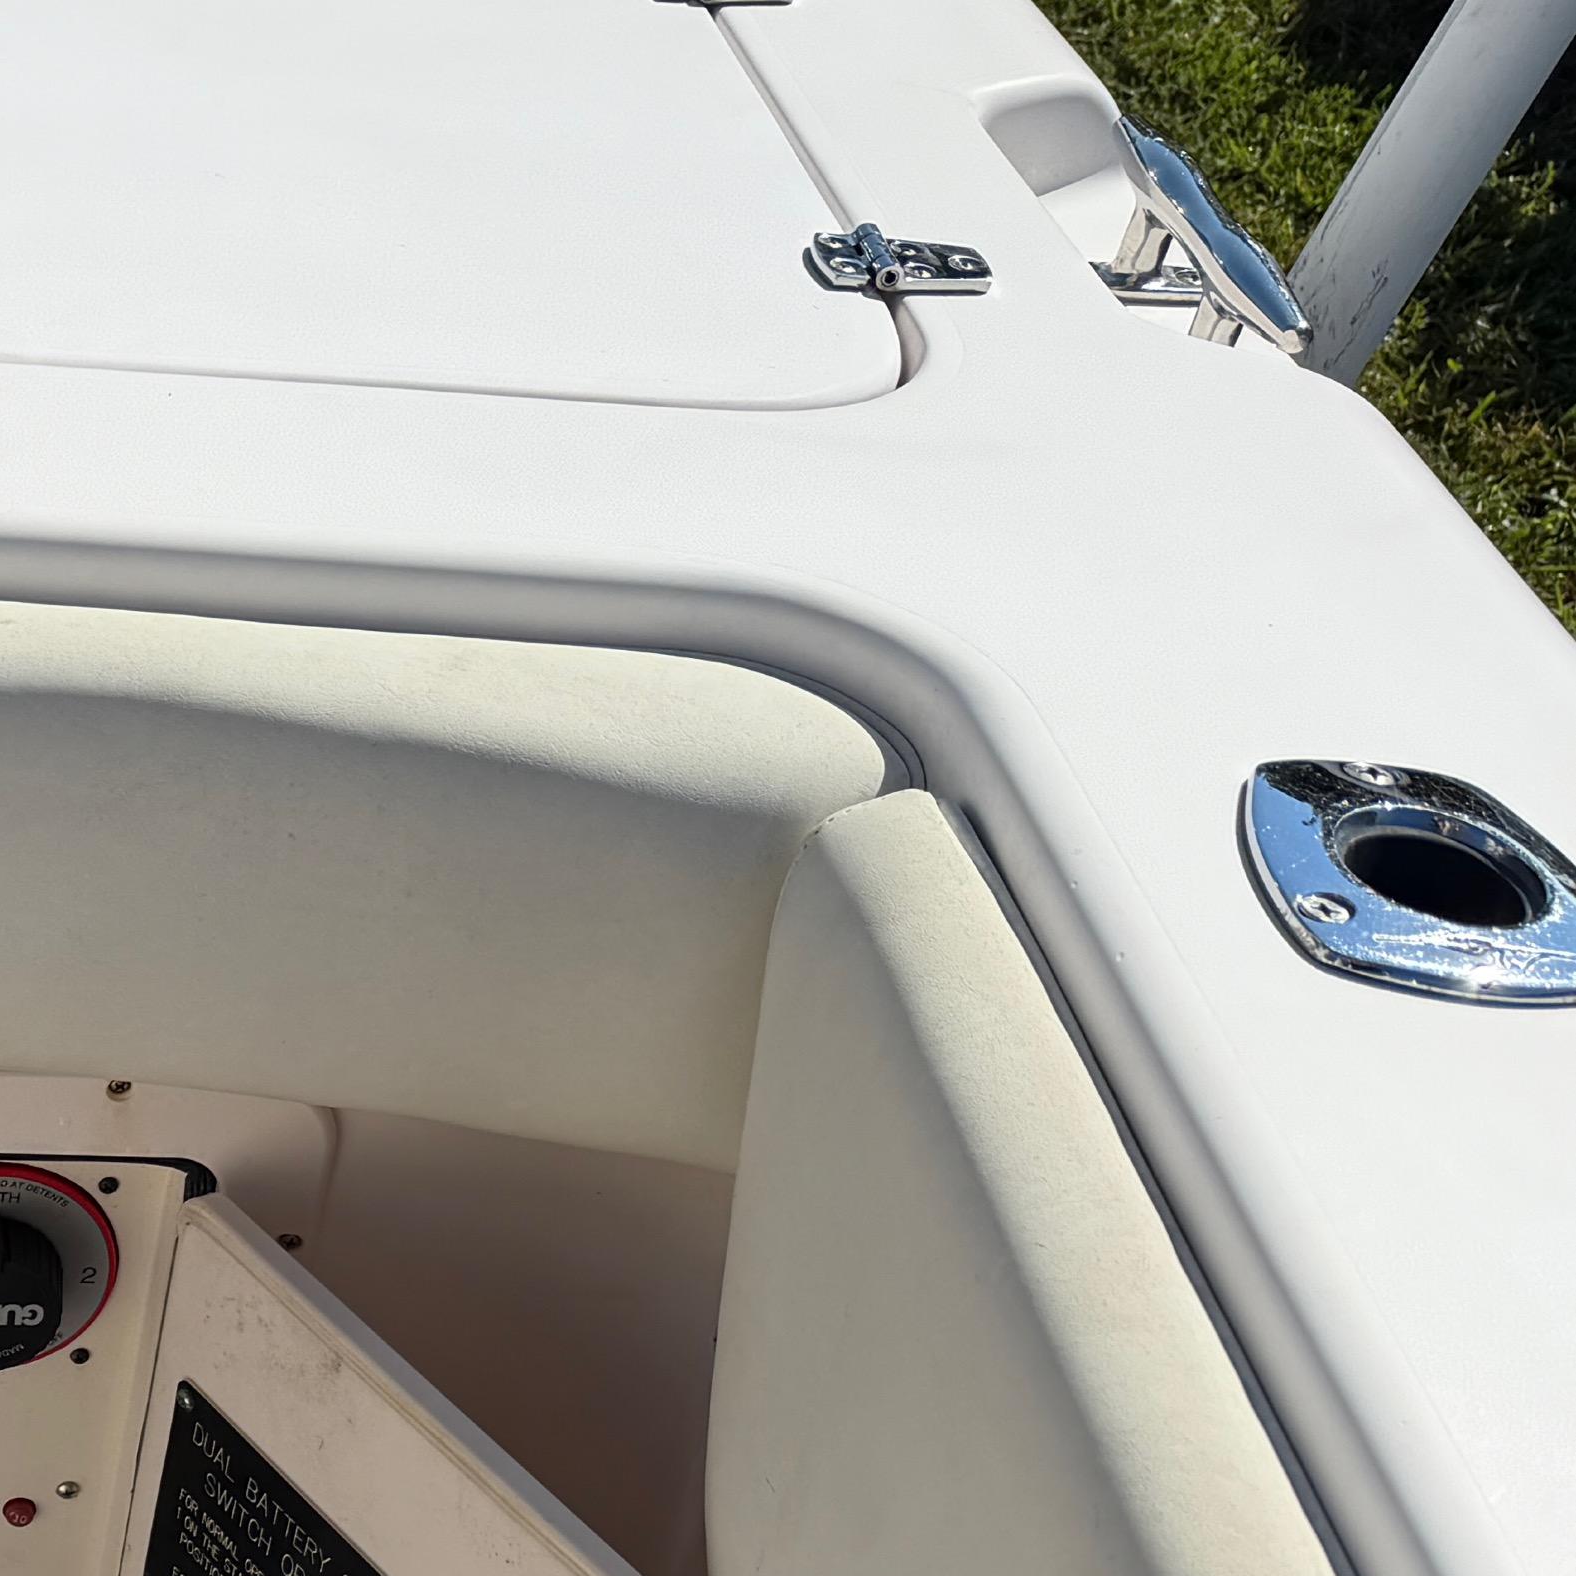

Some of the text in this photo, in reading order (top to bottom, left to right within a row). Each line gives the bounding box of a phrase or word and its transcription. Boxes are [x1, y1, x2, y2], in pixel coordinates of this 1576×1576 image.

[12, 1181, 26, 1189] AT
[26, 1184, 70, 1208] DETENTS
[79, 1266, 97, 1284] 2
[192, 1421, 234, 1483] DUAL
[245, 1477, 332, 1573] BATTERY
[204, 1472, 272, 1556] SWITCH
[178, 1488, 199, 1516] FOR
[201, 1512, 239, 1562] NORMAL
[202, 1533, 220, 1562] THE
